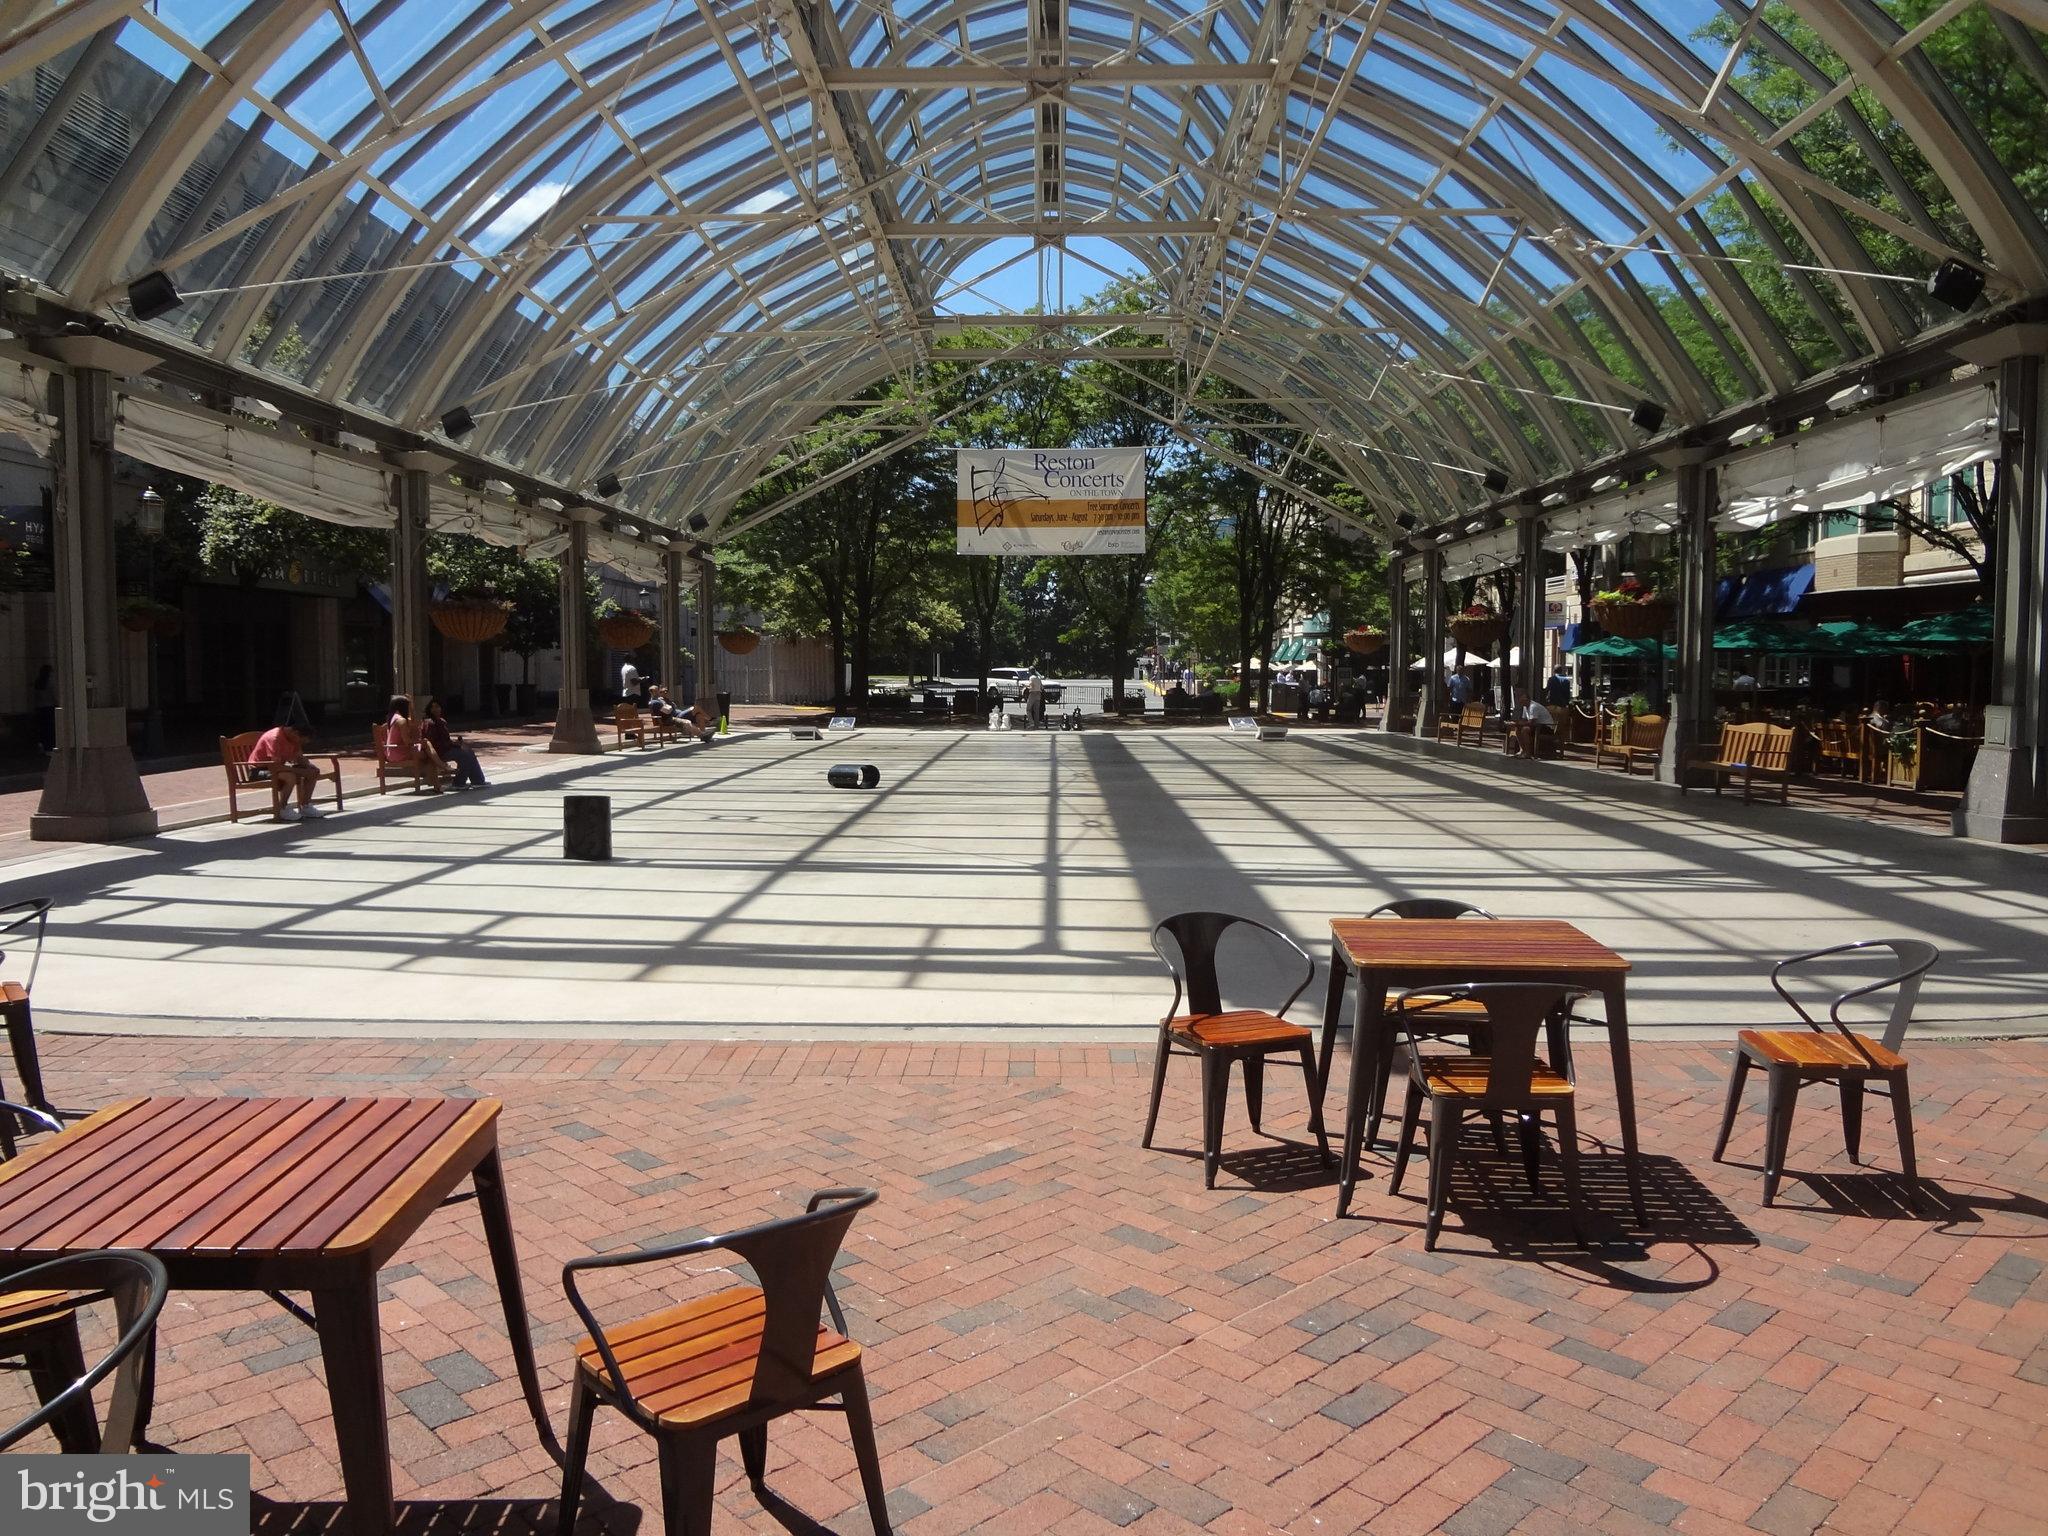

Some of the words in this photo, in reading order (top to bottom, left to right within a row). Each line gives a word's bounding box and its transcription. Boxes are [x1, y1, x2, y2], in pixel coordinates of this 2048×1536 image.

[1034, 453, 1095, 472] Reston
[1044, 470, 1125, 489] Concerts
[1087, 501, 1098, 511] Free
[1099, 501, 1118, 511] Summer
[1119, 501, 1140, 511] Concerts
[1056, 512, 1068, 521] June
[1071, 512, 1088, 523] August
